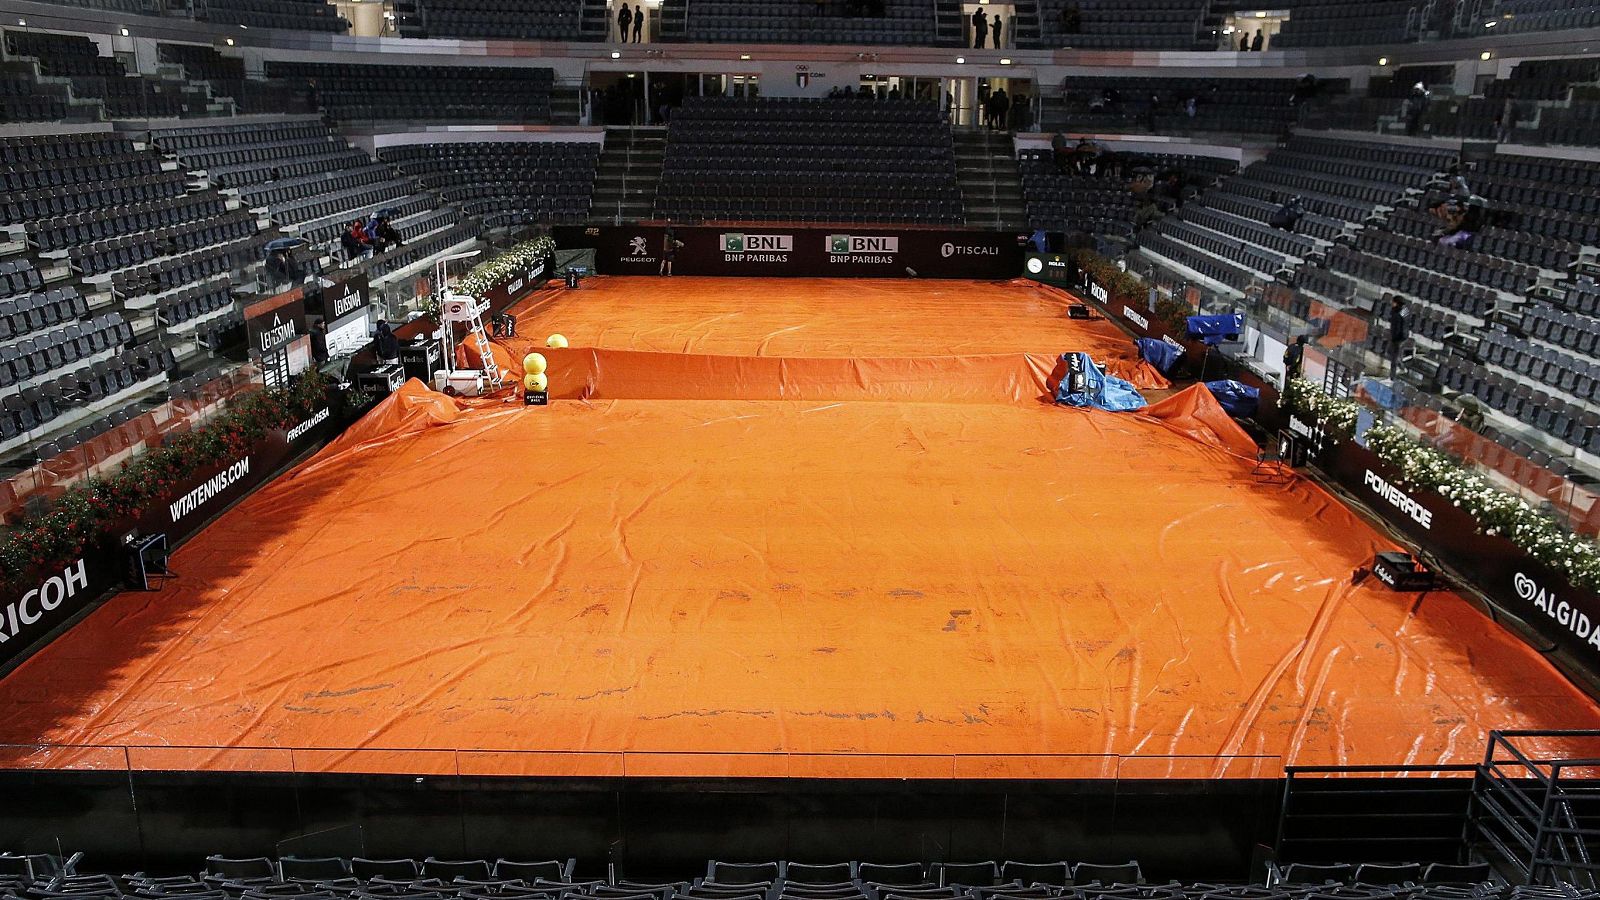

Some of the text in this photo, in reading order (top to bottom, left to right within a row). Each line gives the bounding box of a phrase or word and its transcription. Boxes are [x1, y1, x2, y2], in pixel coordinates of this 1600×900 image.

[747, 236, 787, 249] BNL
[853, 238, 894, 251] BNL
[956, 247, 999, 255] TISCALI
[725, 254, 788, 262] BNP PARIBAS
[830, 255, 893, 264] BNP PARIBAS
[334, 289, 361, 317] LEVISSIMA
[1090, 282, 1108, 304] RICOH
[286, 406, 330, 443] FRECCIAROSSA
[169, 456, 249, 523] WTATENNIS.COM
[1364, 469, 1433, 529] POWERADE
[1534, 587, 1600, 651] ALGIDA
